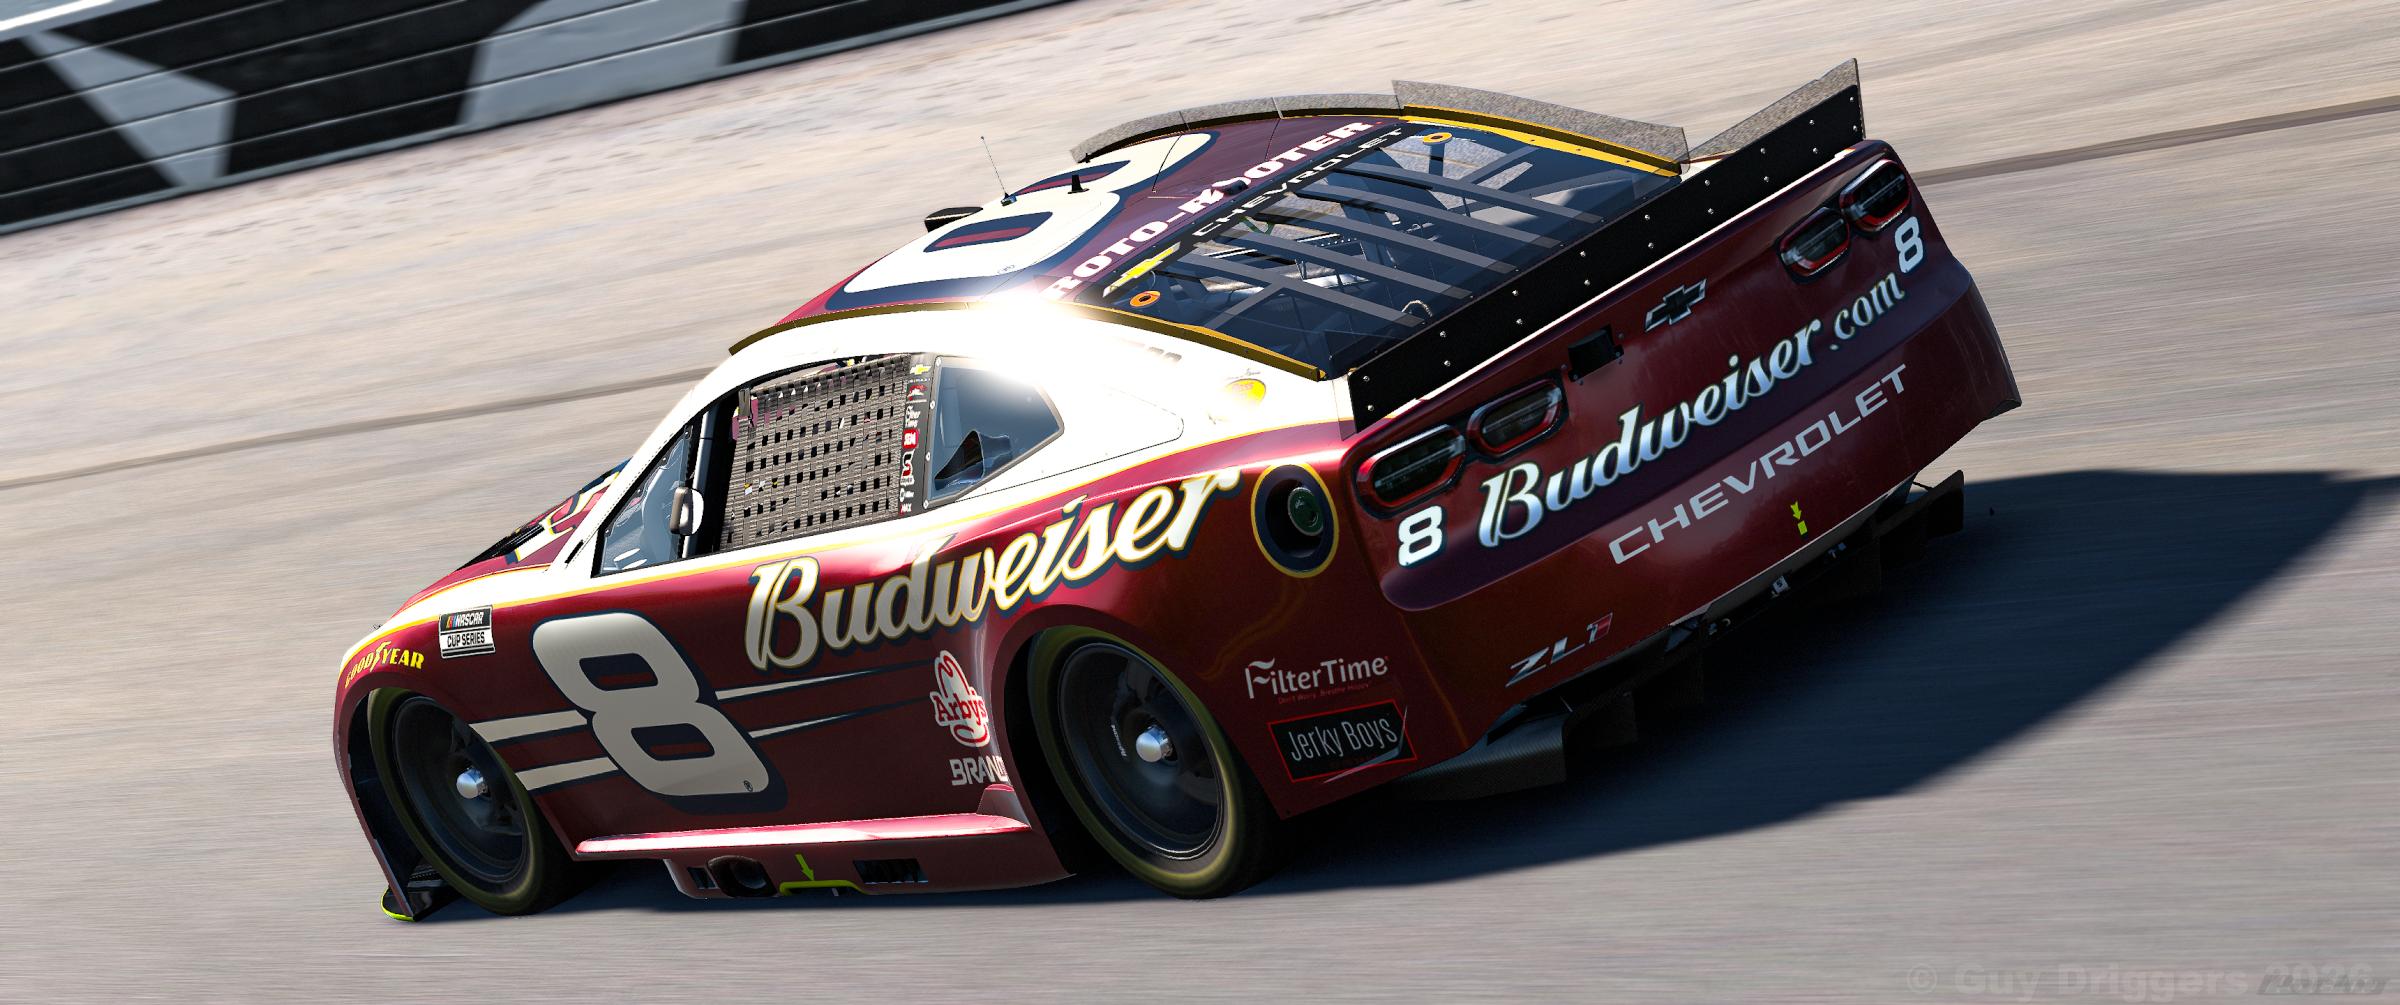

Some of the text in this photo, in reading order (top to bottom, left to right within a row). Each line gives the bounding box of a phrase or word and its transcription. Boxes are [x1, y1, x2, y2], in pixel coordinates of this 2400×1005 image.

[843, 133, 1212, 293] 8
[1192, 127, 1402, 237] CHEVROLET
[1894, 216, 1924, 273] 8
[1478, 318, 1822, 549] Budweiser
[1608, 364, 1908, 565] CHEVROLET
[744, 466, 1245, 671] Budweiser
[1397, 505, 1445, 566] 8
[446, 611, 484, 628] NASCAR
[447, 631, 486, 648] CUP SERIES
[1505, 611, 1613, 688] ZL1
[344, 640, 425, 689] GOODYEAR
[1245, 657, 1388, 699] FilterTime
[532, 612, 769, 796] 8
[1288, 717, 1398, 762] Jerky Boys
